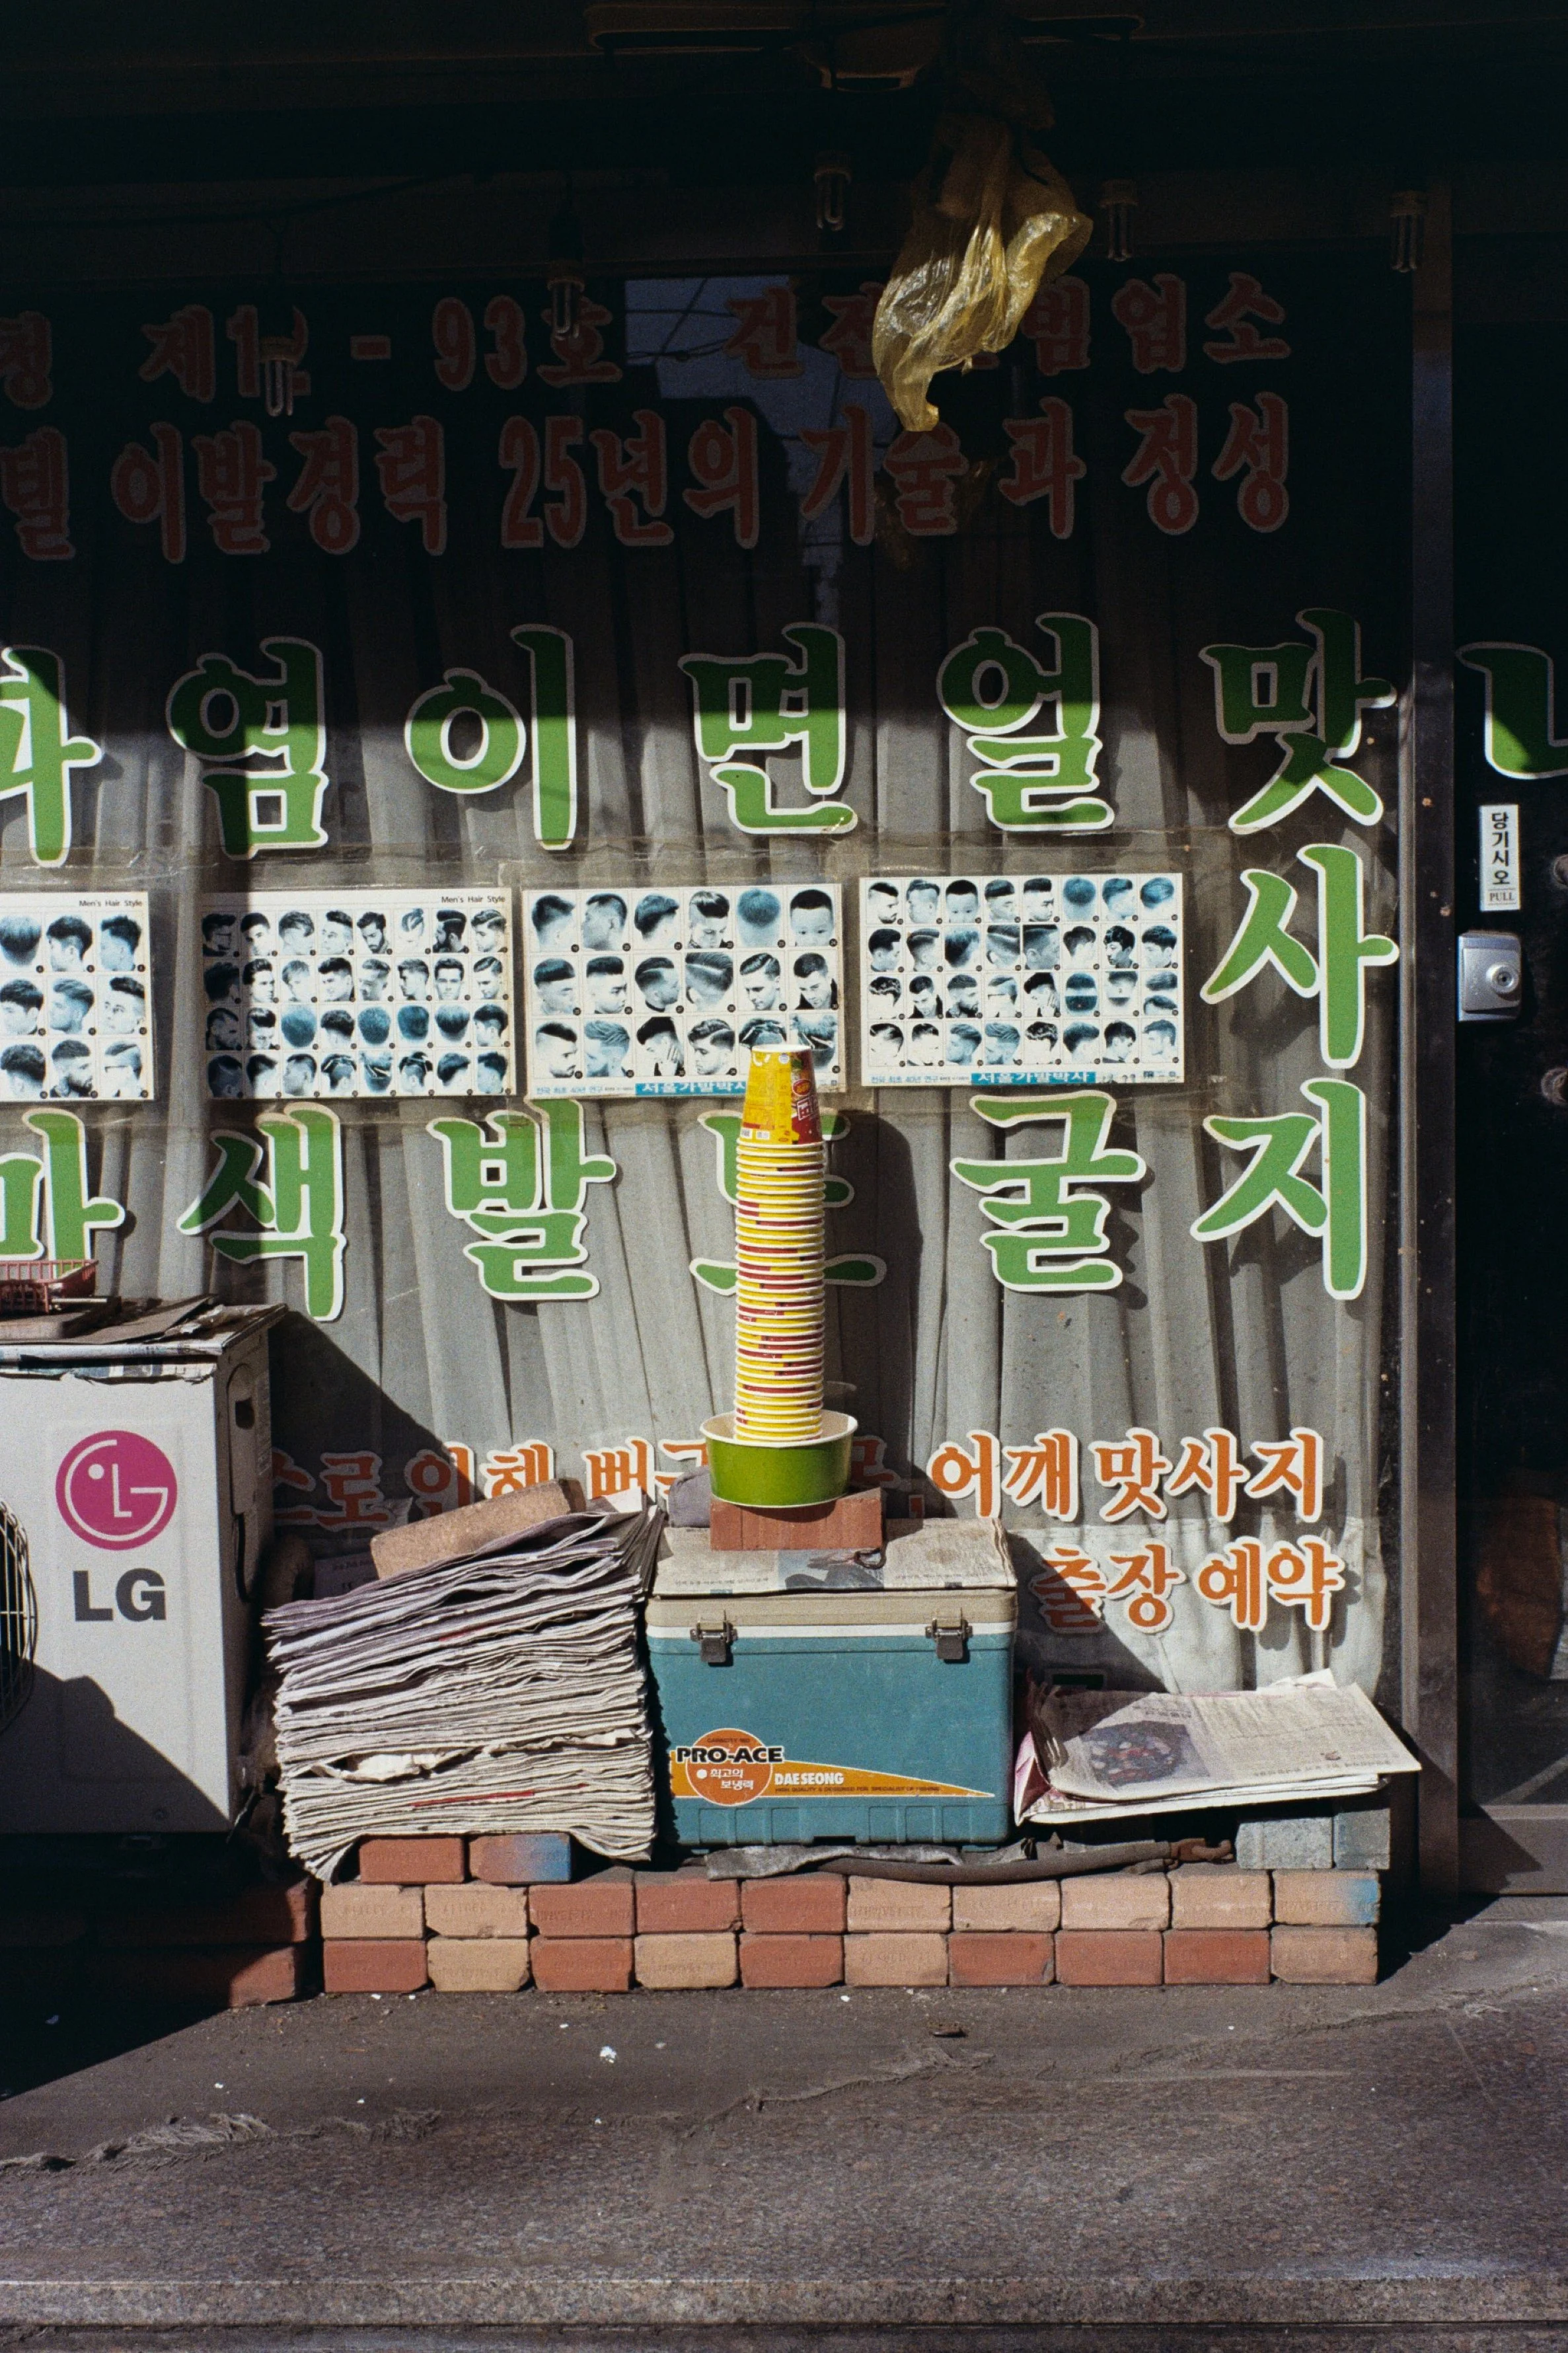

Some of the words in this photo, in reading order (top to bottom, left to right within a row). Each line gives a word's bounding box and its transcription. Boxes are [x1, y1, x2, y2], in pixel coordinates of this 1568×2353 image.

[431, 295, 623, 392] 93호
[1121, 391, 1290, 536] 정성
[1491, 812, 1511, 885] 당기시오
[124, 899, 143, 908] Style
[487, 895, 506, 904] Style
[1489, 892, 1514, 902] PULL
[926, 1428, 1078, 1522] 어깨
[1088, 1427, 1324, 1523] 맛사지
[1032, 1539, 1185, 1633] 출장
[1195, 1535, 1345, 1633] 예약
[73, 1568, 167, 1622] LG
[676, 1746, 784, 1763] PRO-ACE
[710, 1768, 744, 1779] 최고의
[774, 1773, 844, 1785] DAESEONG
[721, 1780, 754, 1791] 보냉력
